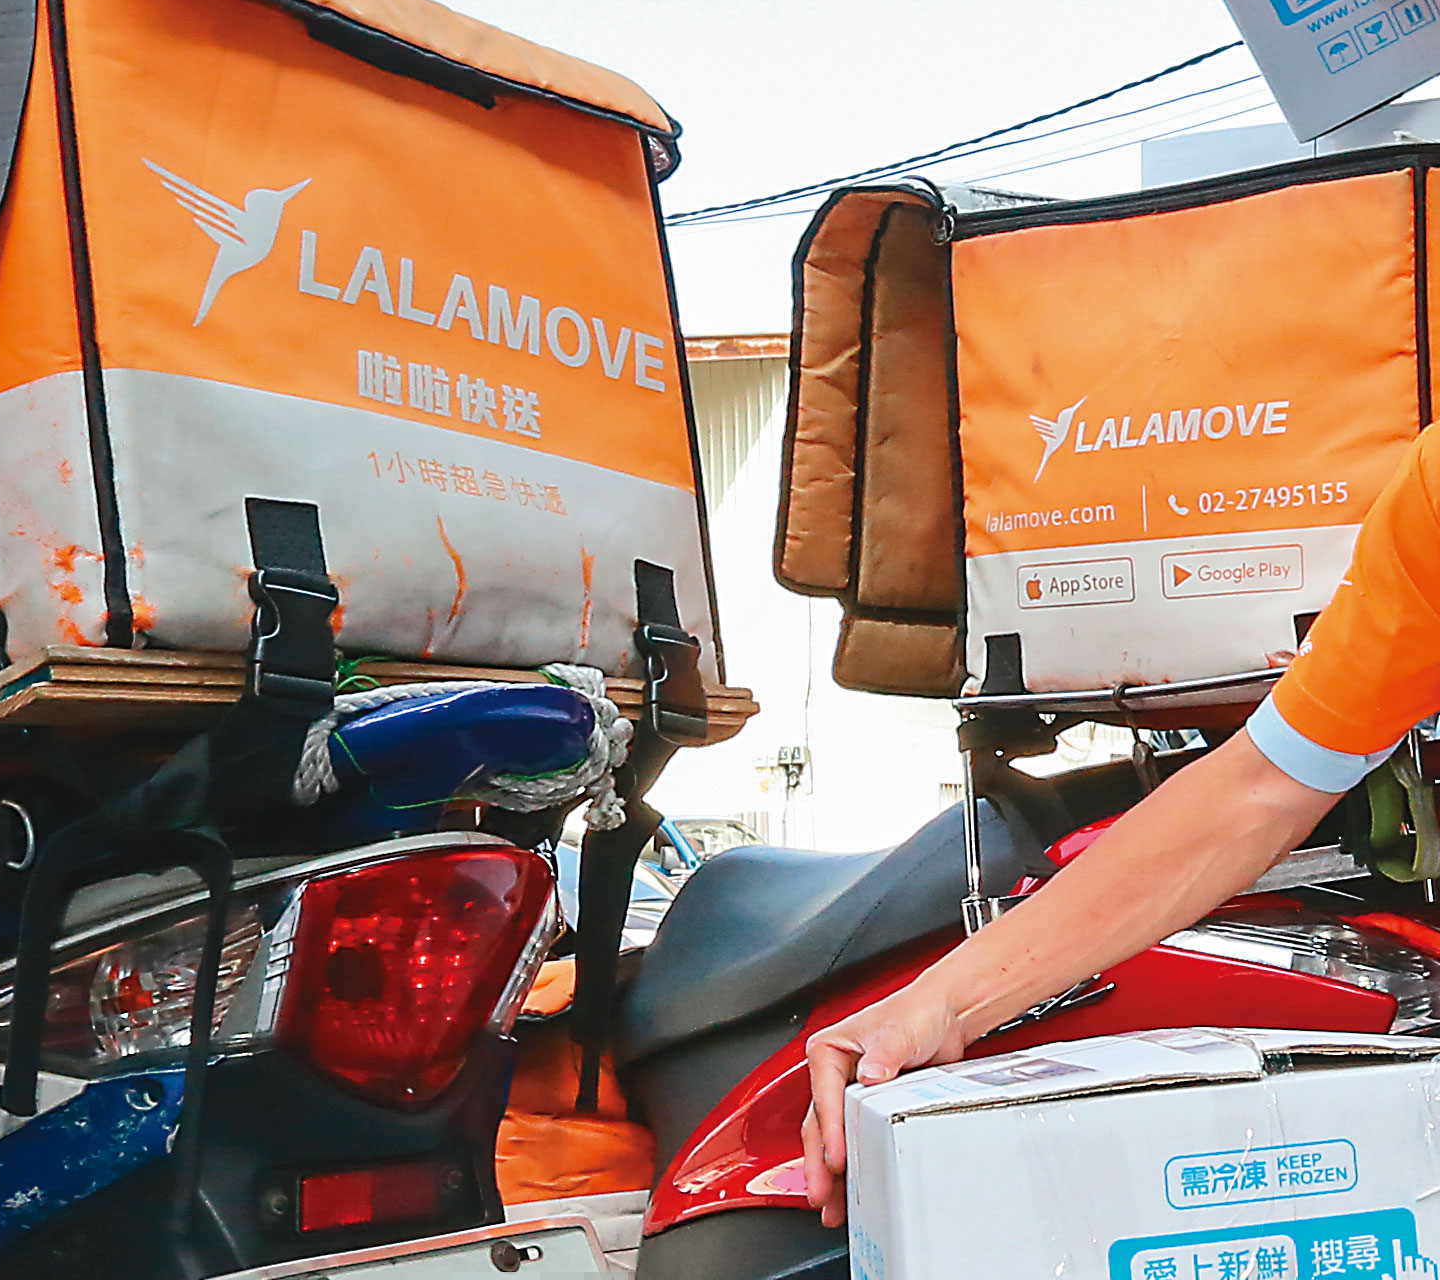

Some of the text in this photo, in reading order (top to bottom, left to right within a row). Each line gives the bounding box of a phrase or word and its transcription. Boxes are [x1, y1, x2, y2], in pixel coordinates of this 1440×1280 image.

[299, 229, 665, 392] LALAMOVE
[357, 350, 542, 439] 啦啦快送
[1074, 400, 1290, 453] LALAMOVE
[366, 451, 569, 516] 1小時超急快遞
[1198, 481, 1348, 515] 02-27495155
[985, 502, 1116, 533] lalamove.com
[1049, 573, 1124, 596] App Store
[1197, 555, 1291, 585] Google Play
[1181, 1160, 1268, 1198] 需冷凍
[1277, 1152, 1322, 1170] KEEP
[1278, 1167, 1348, 1188] FROZEN
[1310, 1234, 1381, 1278] 搜尋
